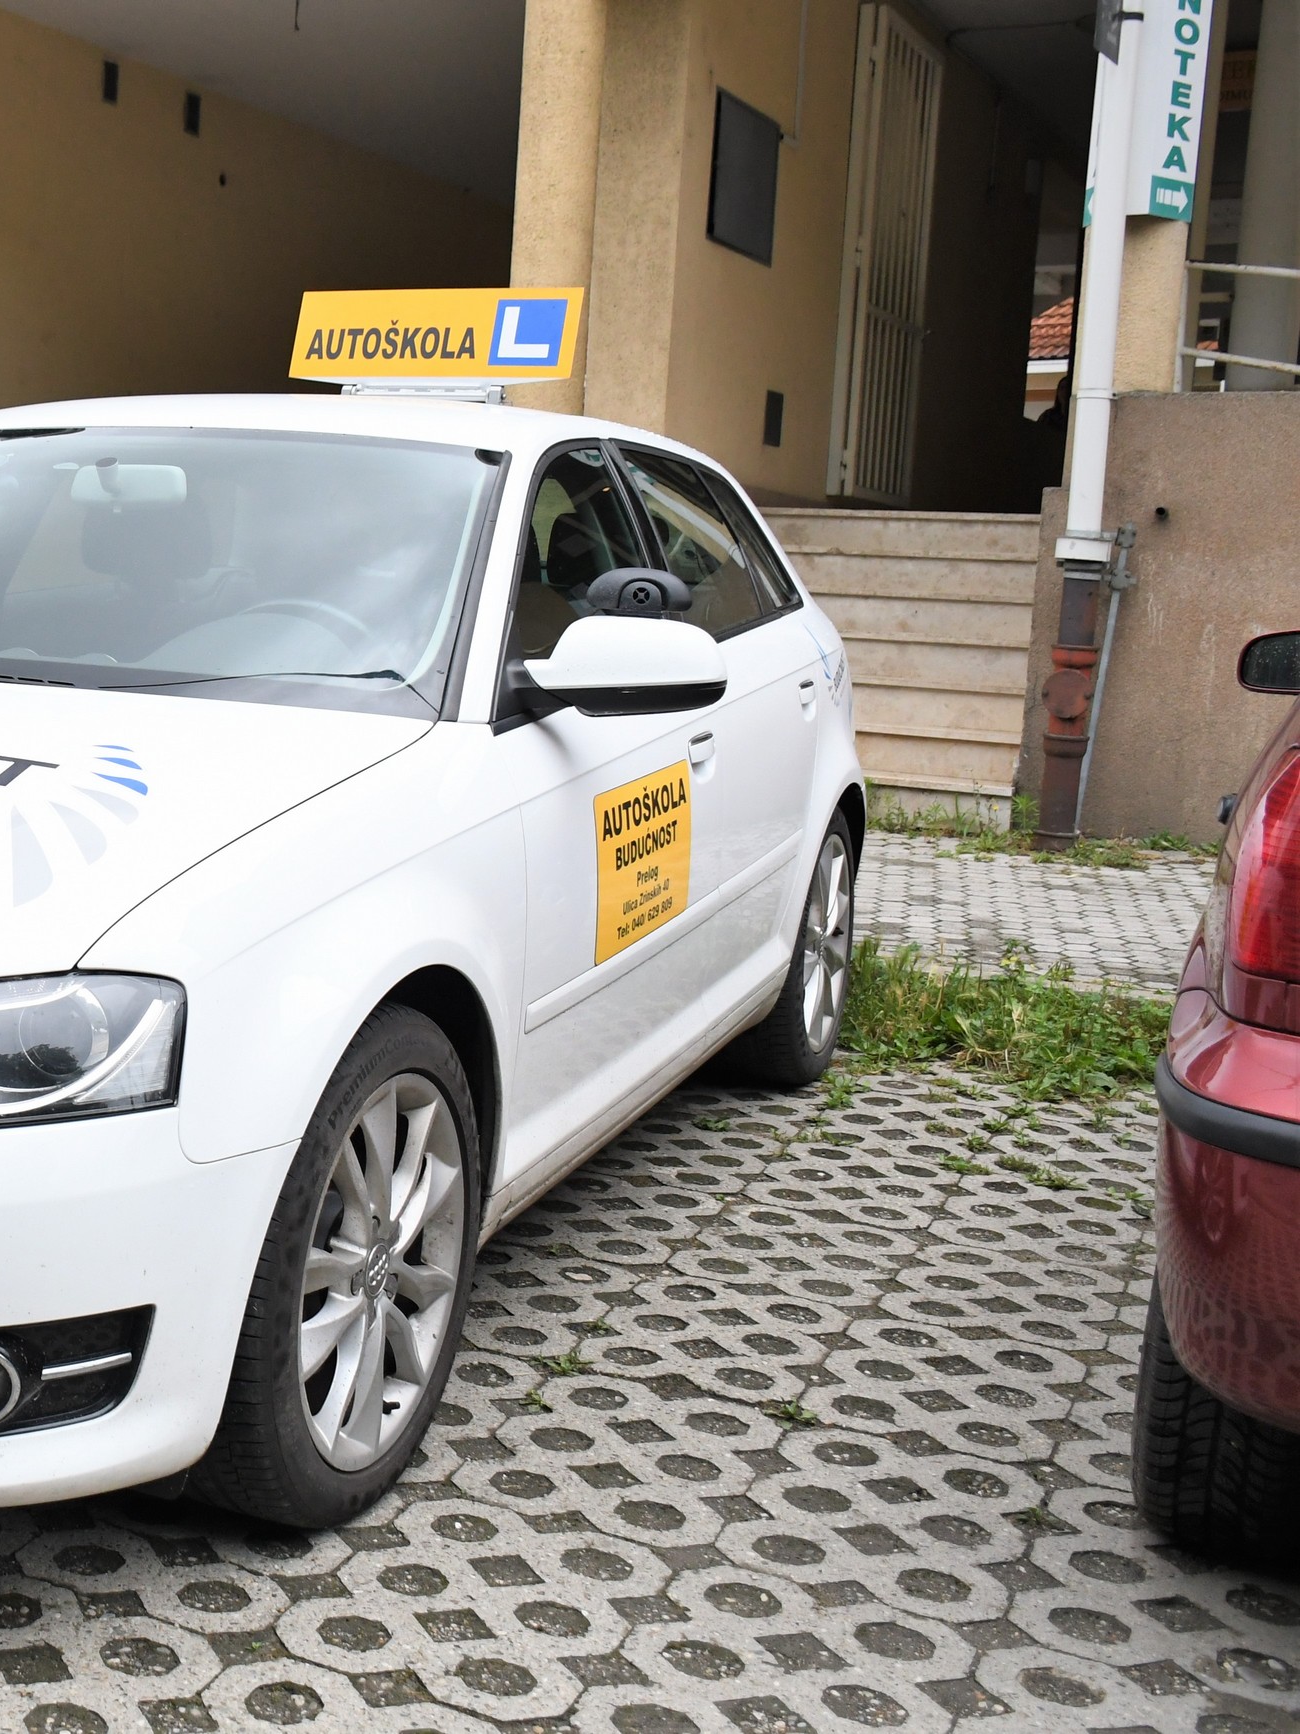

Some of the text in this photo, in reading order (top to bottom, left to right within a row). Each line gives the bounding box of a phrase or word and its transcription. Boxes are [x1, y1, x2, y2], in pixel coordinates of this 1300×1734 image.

[305, 306, 550, 360] AUTOŠKOLA L
[602, 778, 687, 842] AUTOŠKOLA
[615, 820, 678, 871] BUDUĆNOST
[636, 866, 659, 887] Prelog
[617, 922, 630, 940] Tel:
[647, 904, 660, 921] 629
[622, 898, 638, 916] Ulica
